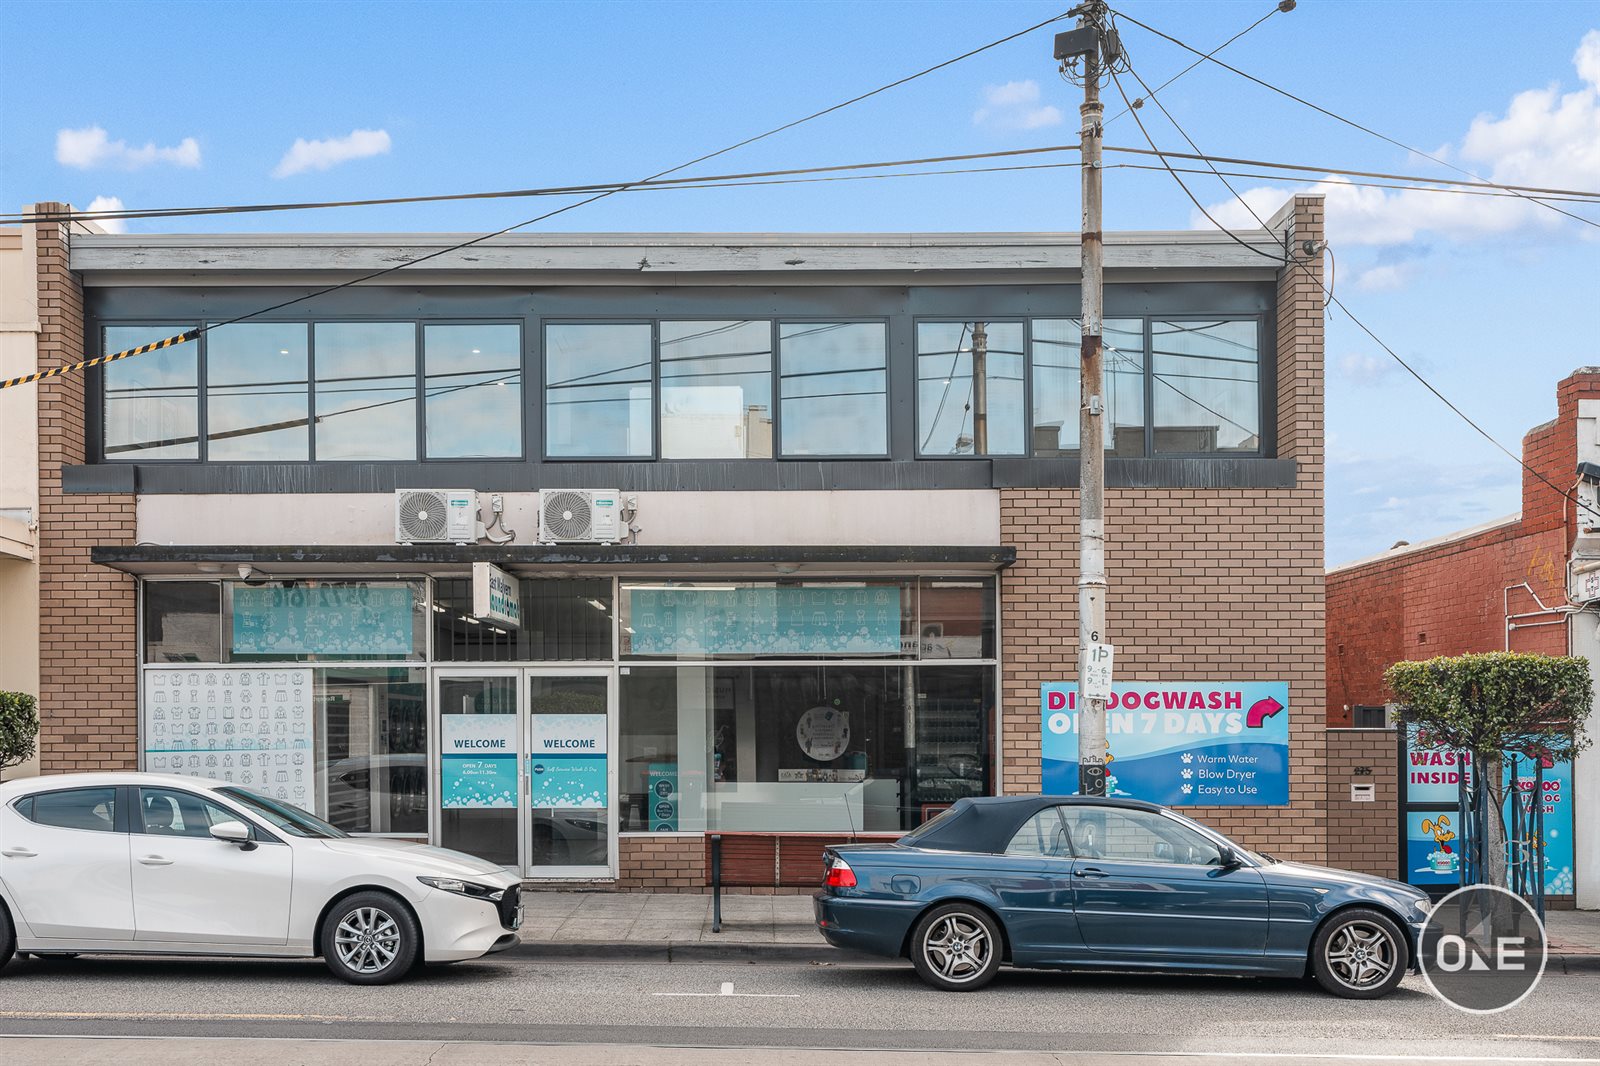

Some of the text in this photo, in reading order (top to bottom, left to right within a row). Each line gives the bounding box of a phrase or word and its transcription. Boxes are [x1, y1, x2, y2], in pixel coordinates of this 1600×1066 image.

[1091, 631, 1099, 641] 6
[1048, 692, 1076, 709] DI
[1048, 712, 1243, 734] ON 7 DAYS
[454, 739, 506, 748] WELCOME
[543, 739, 595, 748] WELCOME
[1197, 755, 1258, 763] Warm Water
[1410, 752, 1471, 766] WASH
[1198, 769, 1257, 781] Blow Dryer
[1410, 772, 1471, 784] INSIDE
[1198, 784, 1258, 796] Easy to Use
